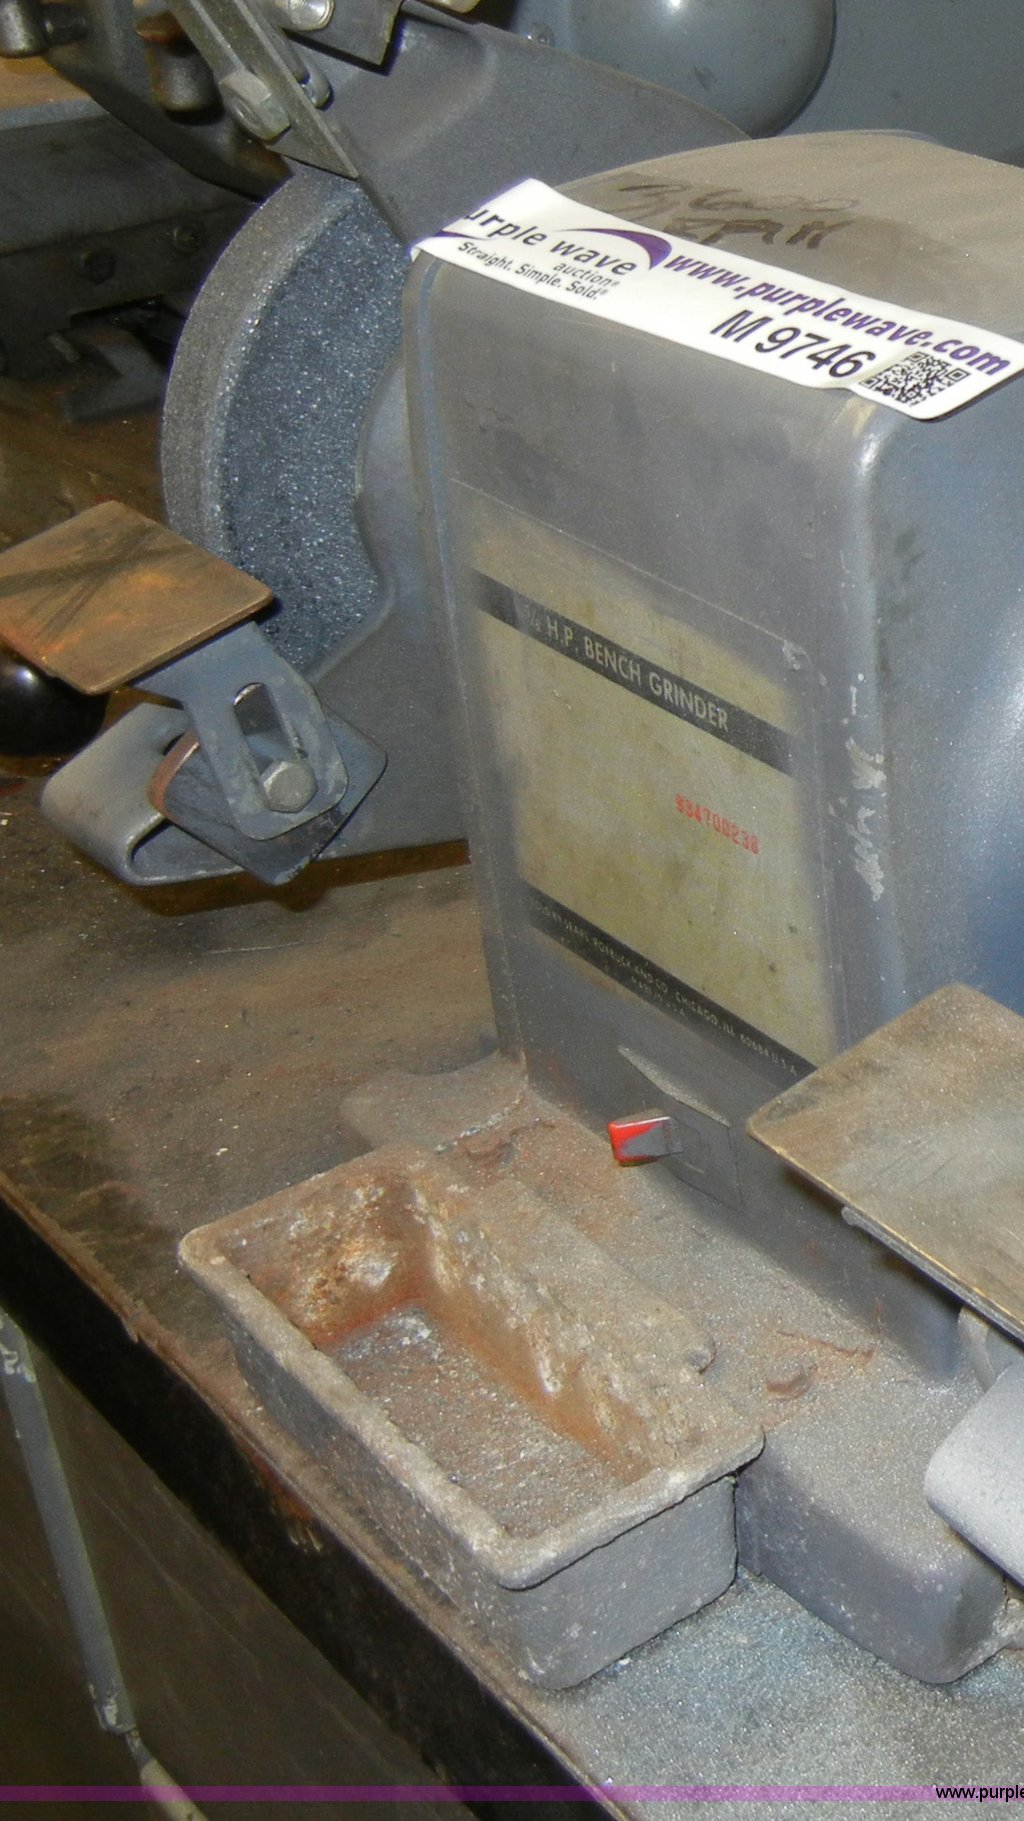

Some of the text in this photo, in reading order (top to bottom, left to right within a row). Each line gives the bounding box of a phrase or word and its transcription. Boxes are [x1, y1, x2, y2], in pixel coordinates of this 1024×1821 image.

[457, 240, 512, 271] Straight.
[514, 263, 562, 289] Simple.
[463, 208, 637, 275] urple wave
[663, 254, 1012, 376] www.purplewave.com
[709, 309, 877, 379] M 9746
[584, 635, 642, 686] BENCH
[649, 671, 729, 732] GRINDER
